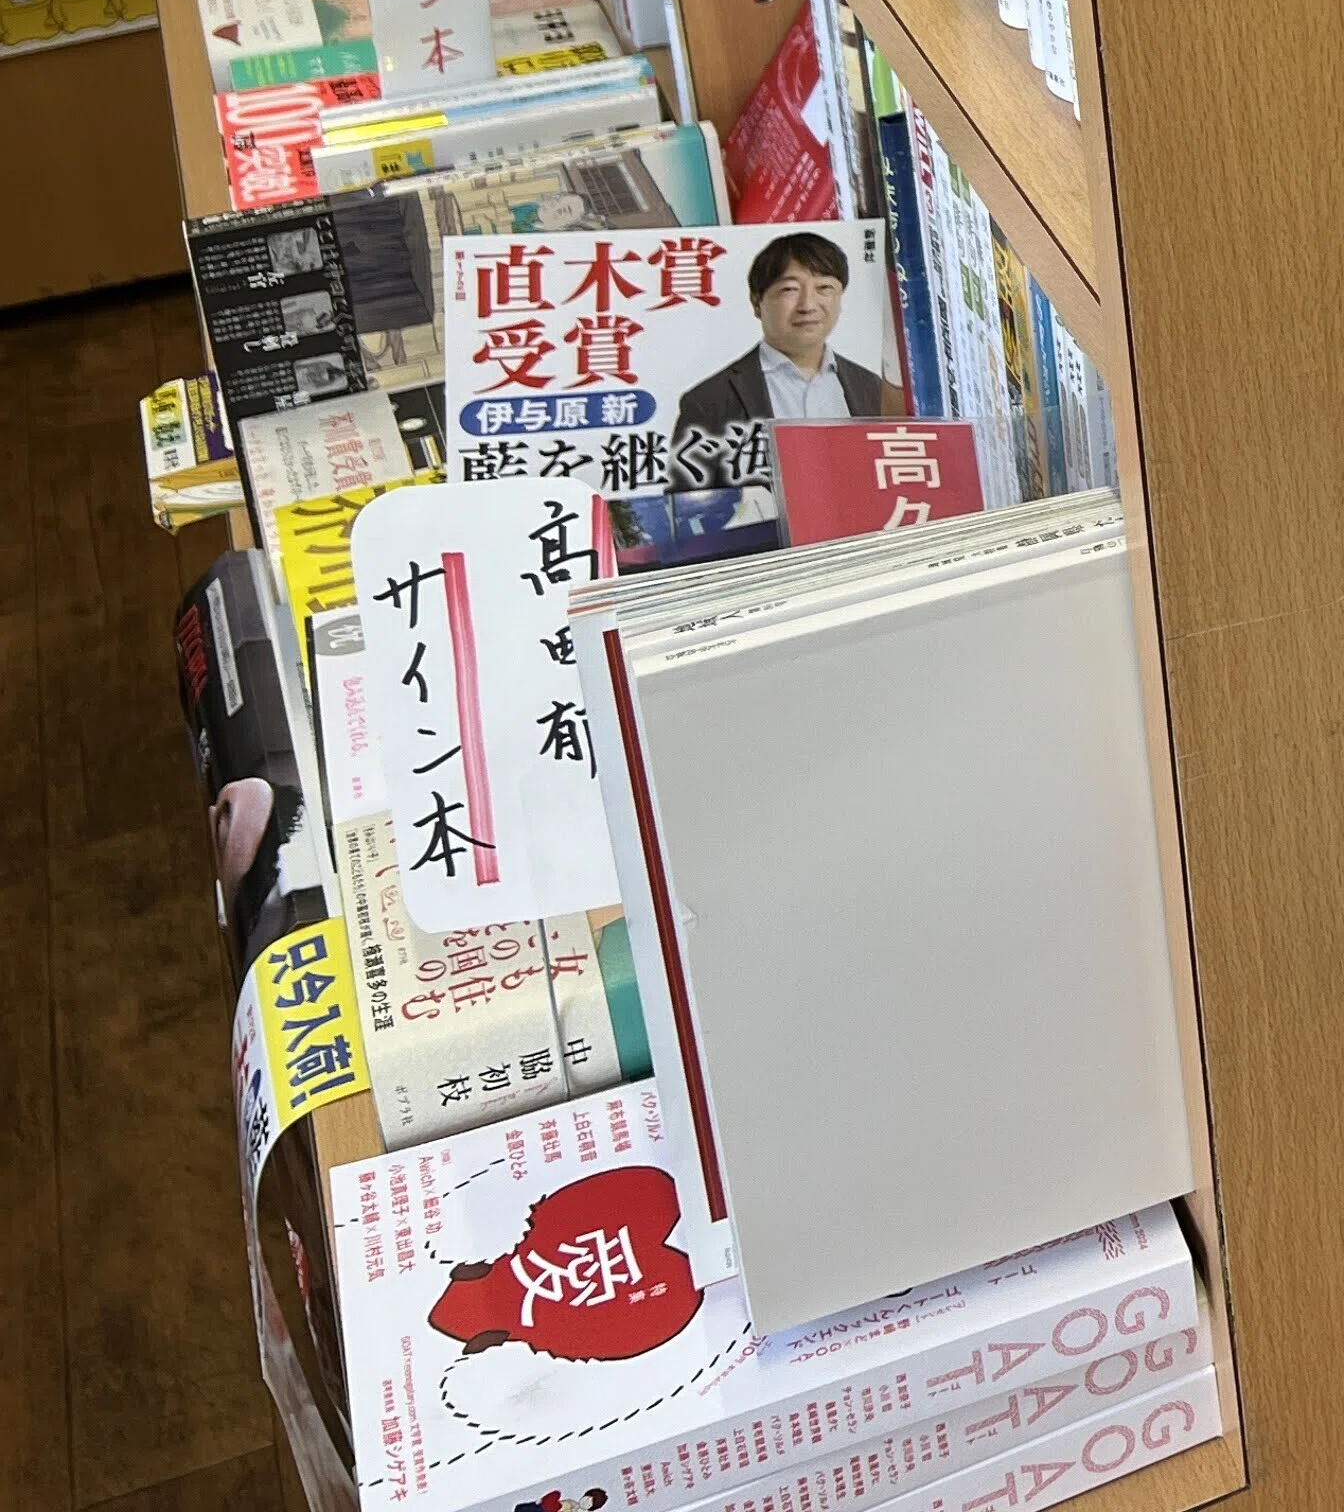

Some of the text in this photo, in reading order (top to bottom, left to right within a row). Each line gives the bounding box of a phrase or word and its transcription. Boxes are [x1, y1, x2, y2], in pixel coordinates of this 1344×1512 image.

[473, 237, 729, 320] 直木賞
[471, 315, 645, 394] 受賞
[475, 394, 639, 431] 伊与原 新
[373, 558, 497, 881] サイン本
[510, 1225, 643, 1328] 愛
[925, 1285, 1171, 1391] GOAT
